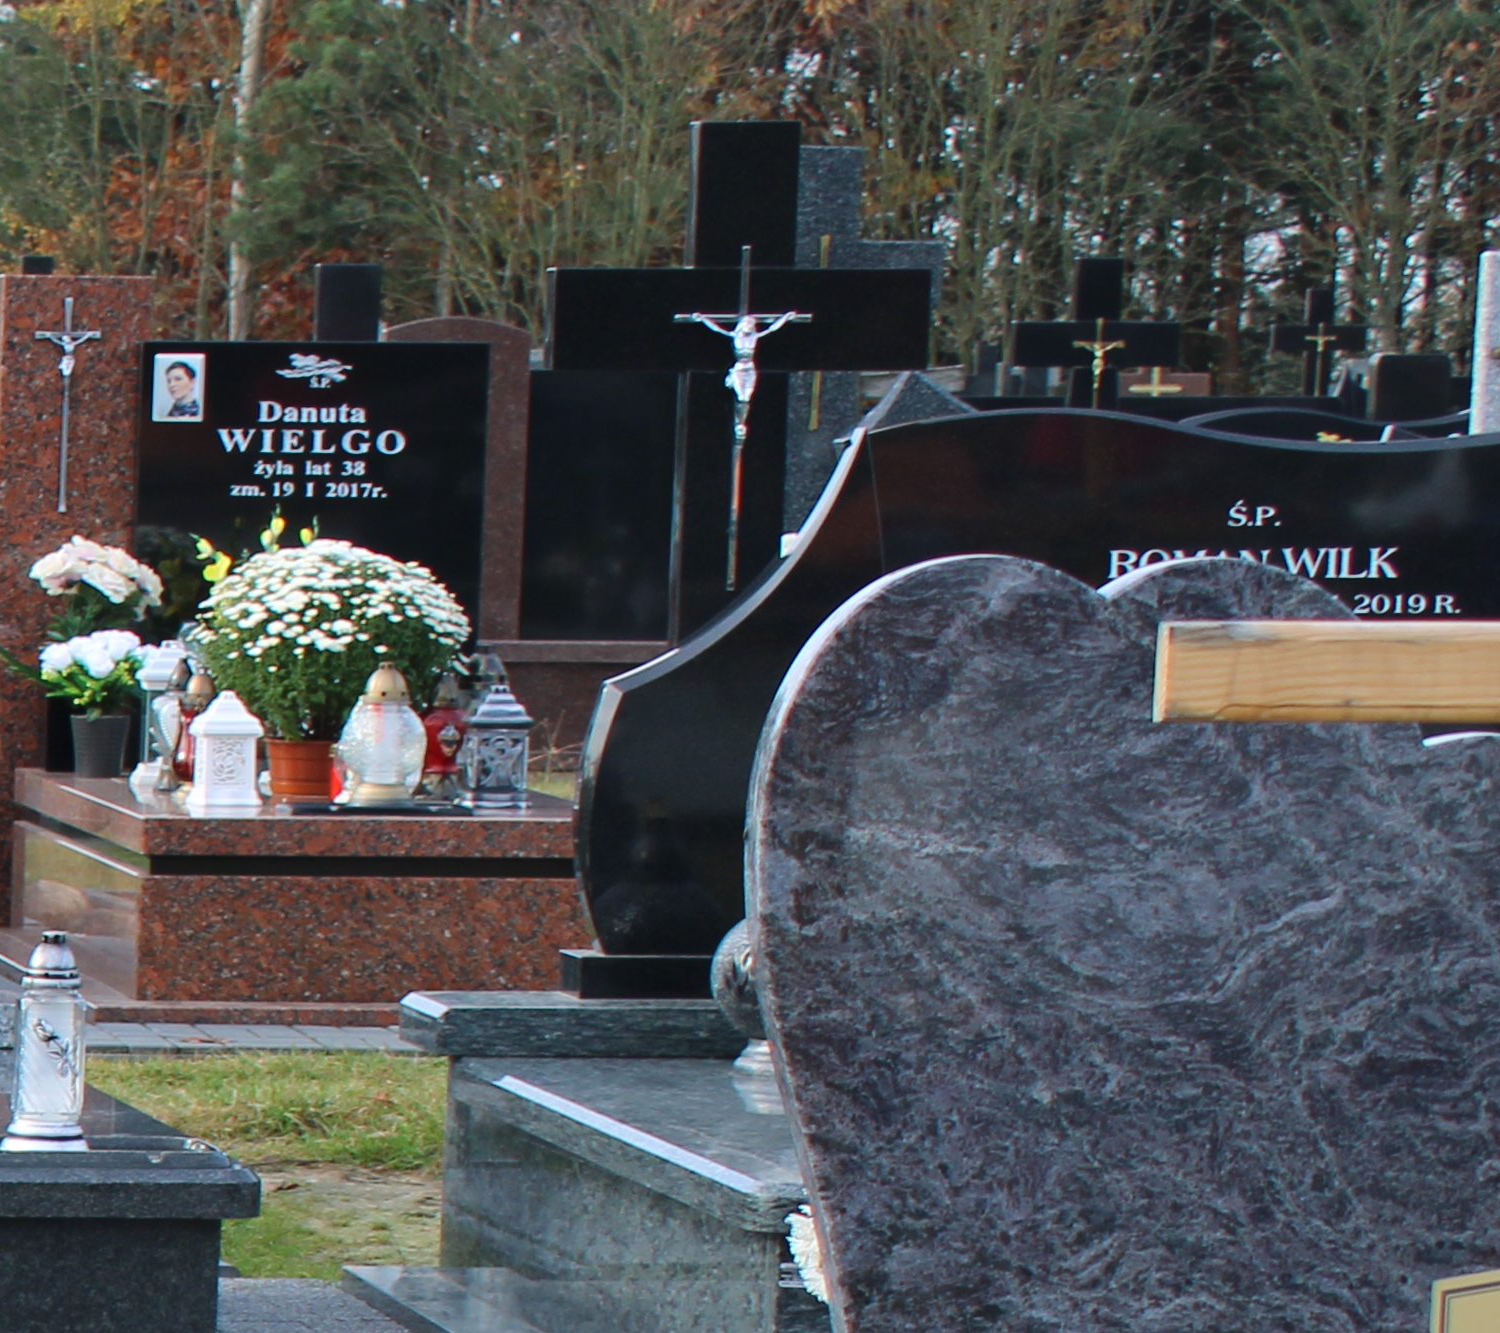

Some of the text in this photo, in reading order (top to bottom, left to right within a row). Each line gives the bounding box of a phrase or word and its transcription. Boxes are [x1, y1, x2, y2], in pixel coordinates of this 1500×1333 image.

[257, 401, 367, 424] Danuta
[217, 428, 406, 455] WIELGO
[305, 460, 331, 476] lat
[341, 460, 366, 476] 38
[230, 484, 266, 497] zm.
[272, 482, 295, 497] 19
[1281, 547, 1399, 579] WILK
[1352, 593, 1462, 616] 2019 R.
